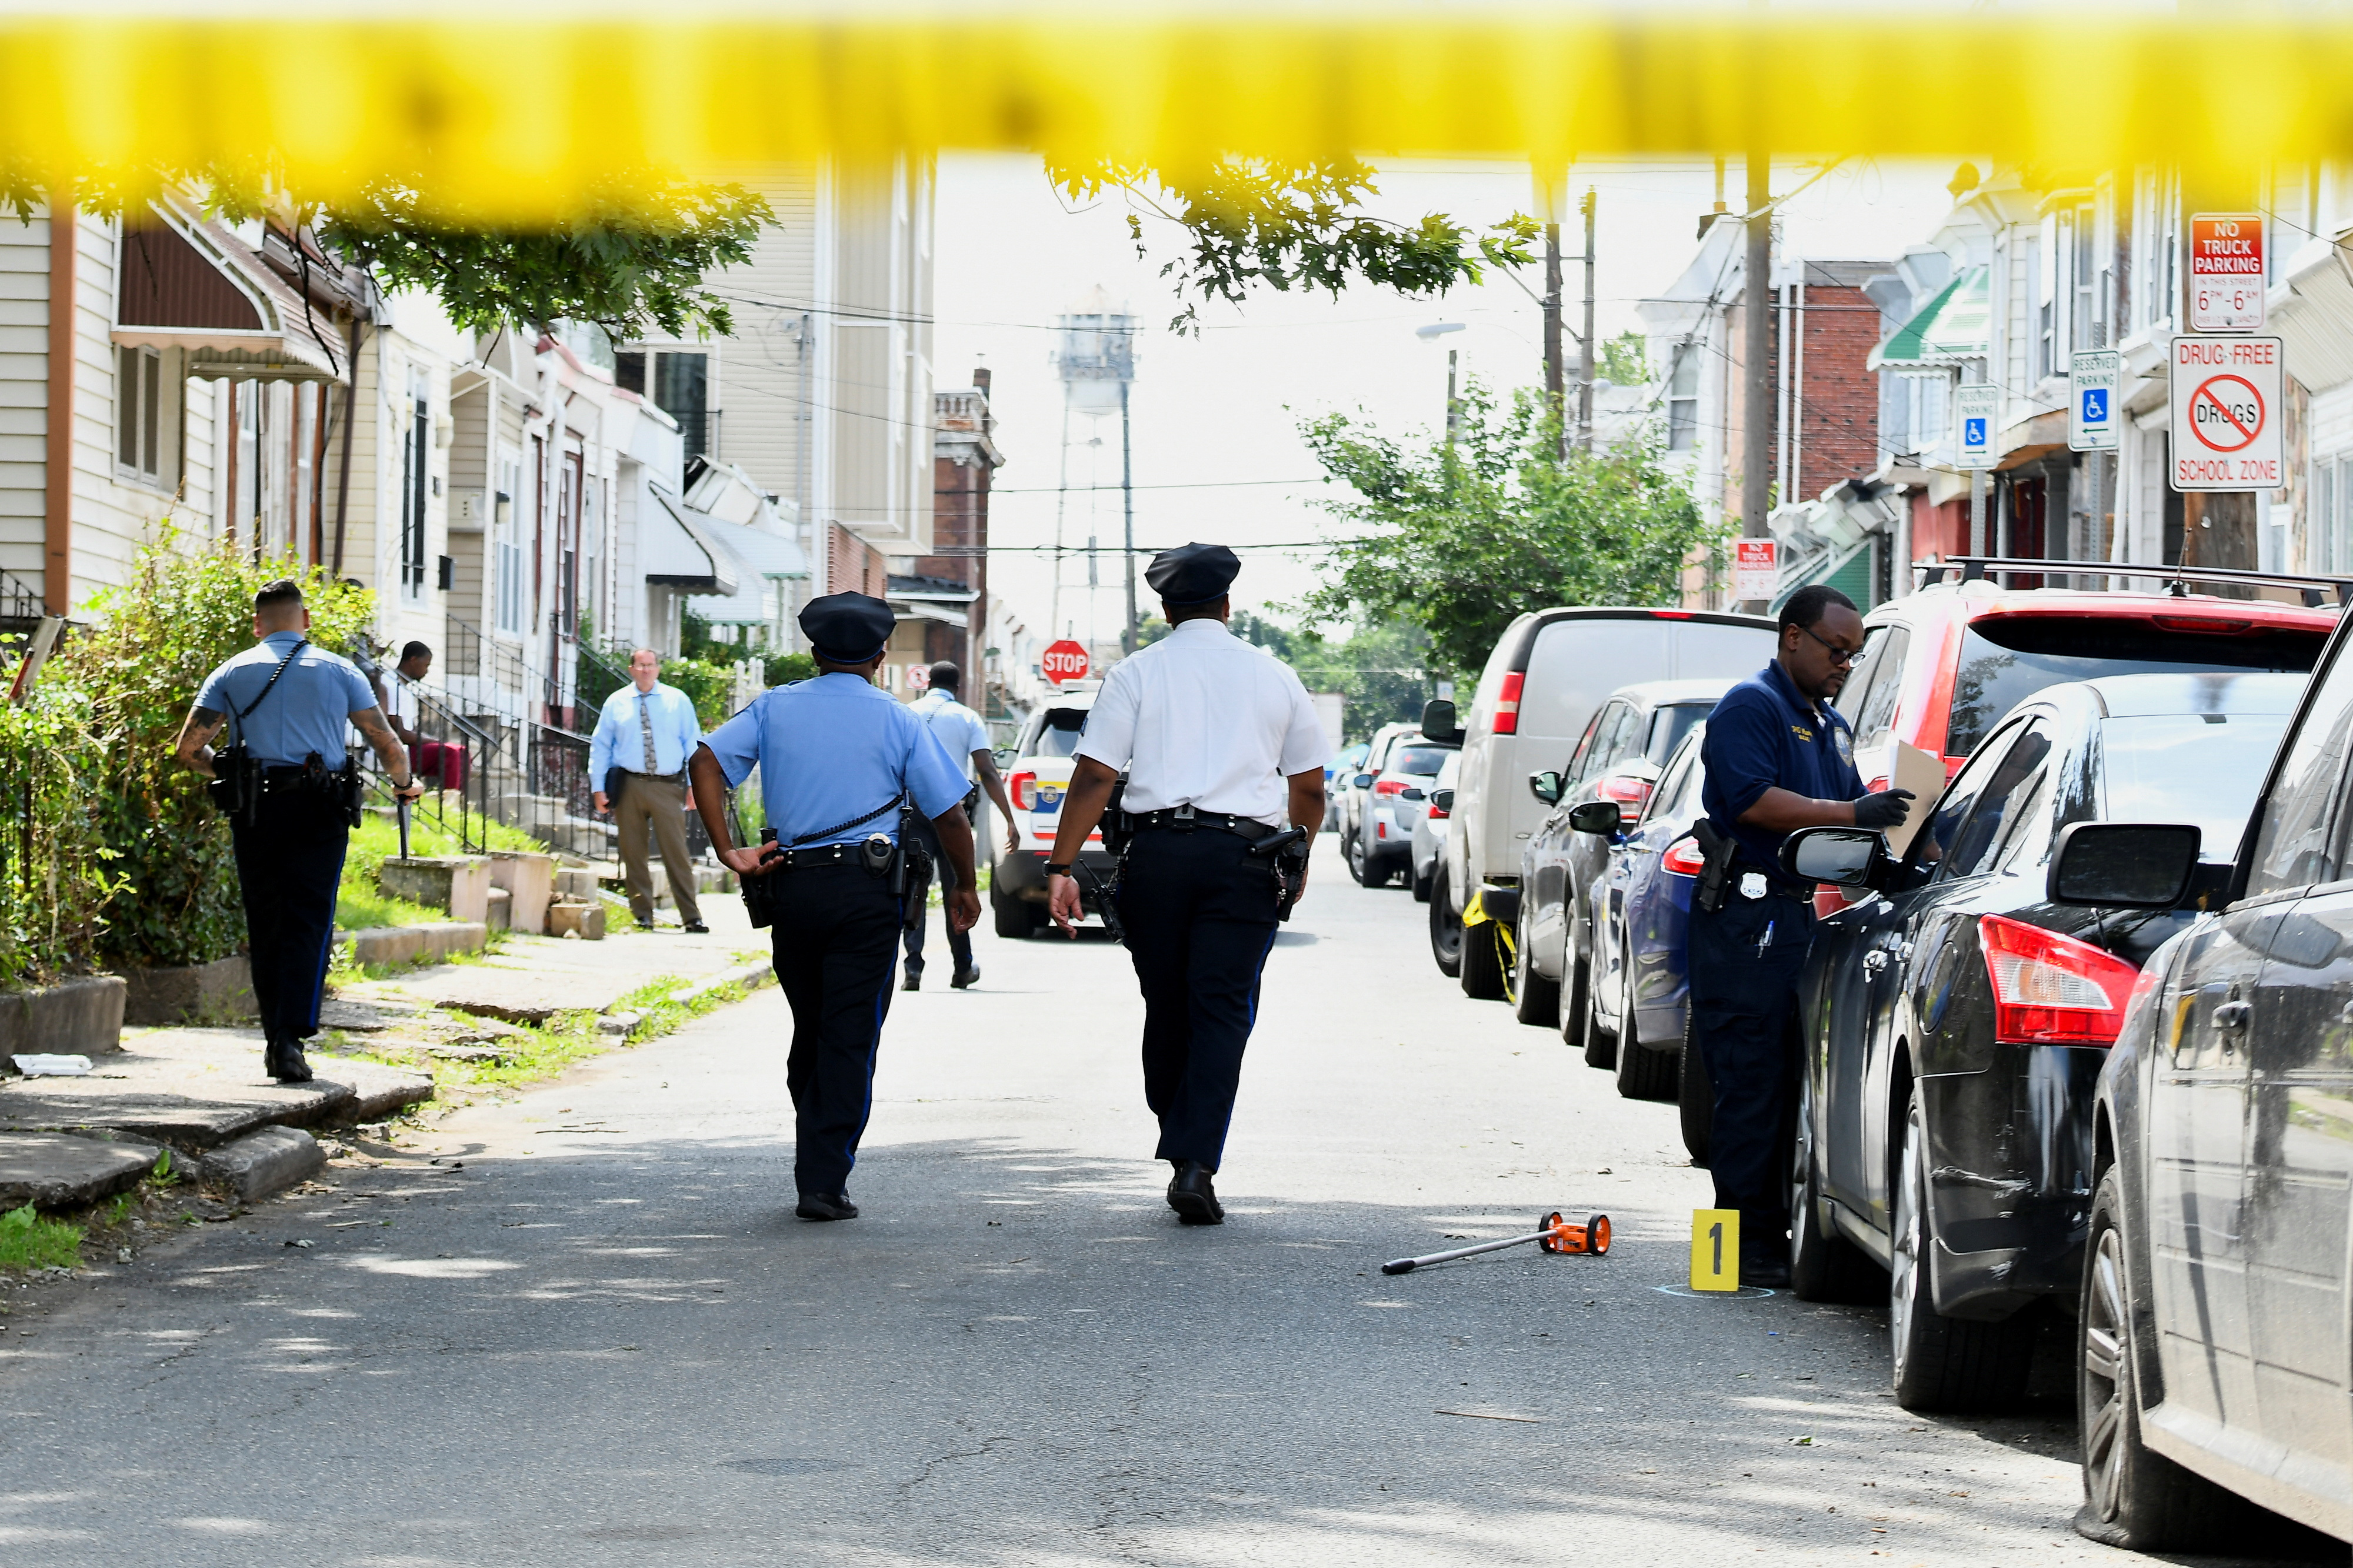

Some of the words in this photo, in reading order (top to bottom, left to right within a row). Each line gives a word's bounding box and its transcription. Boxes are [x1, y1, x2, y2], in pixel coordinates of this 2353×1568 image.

[2215, 222, 2239, 237] NO
[2202, 239, 2252, 255] TRUCK
[2195, 257, 2260, 272] PARKING
[2229, 278, 2257, 286] STREET
[2074, 357, 2116, 371] RESERVED
[2077, 373, 2114, 386] PARKING
[2197, 404, 2256, 423] DRUGS
[2179, 460, 2234, 481] SCHOOL
[2240, 460, 2277, 481] ZONE
[1748, 543, 1764, 552] NO
[1742, 552, 1769, 561] TRUCK
[1044, 653, 1086, 673] STOP
[1709, 1223, 1722, 1275] 1
